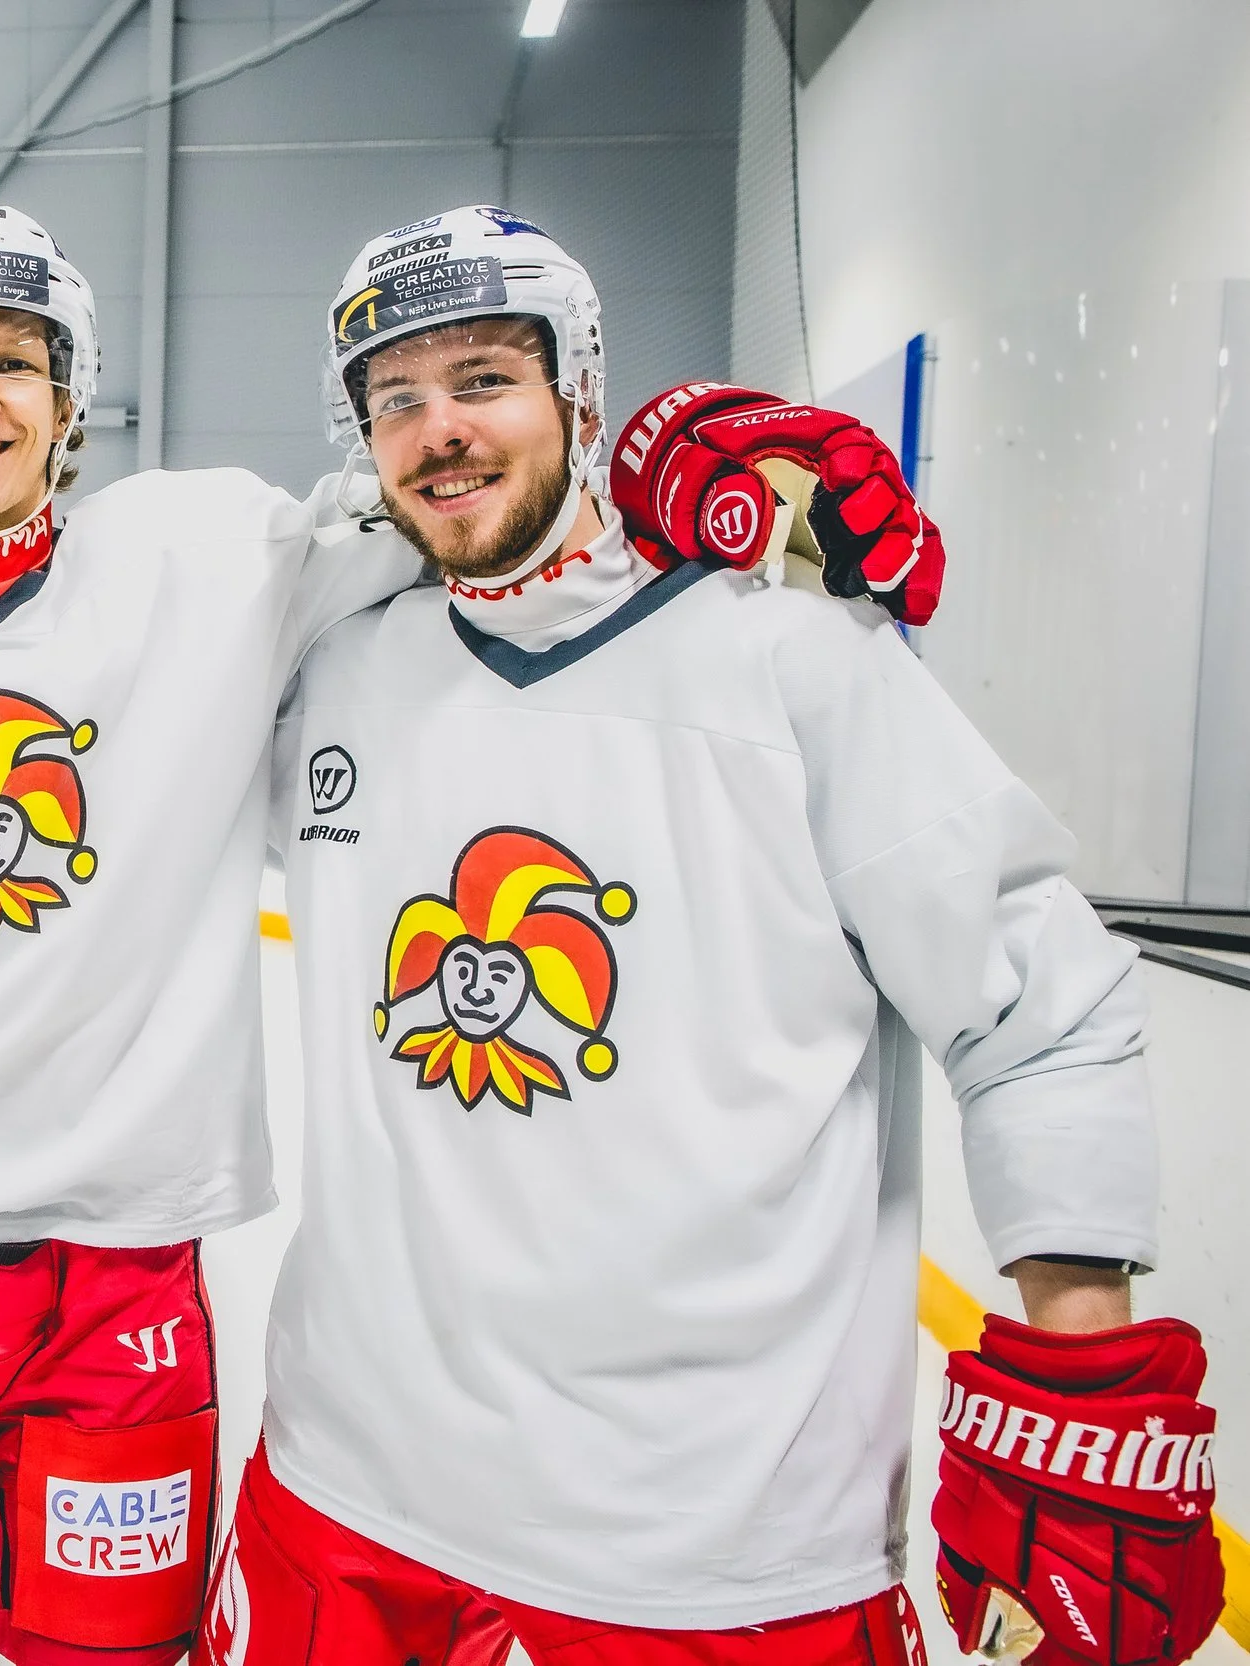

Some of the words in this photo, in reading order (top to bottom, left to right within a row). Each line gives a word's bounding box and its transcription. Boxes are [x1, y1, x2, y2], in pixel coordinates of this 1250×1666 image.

[373, 237, 446, 267] PAIKKA
[367, 251, 450, 286] WARRIOR
[393, 261, 489, 291] CREATIVE
[3, 286, 30, 297] Events
[396, 274, 490, 301] TECHNOLOGY
[408, 305, 427, 317] NEP
[428, 301, 447, 312] Live
[449, 295, 481, 306] Events
[732, 410, 813, 428] ALPHA
[51, 1480, 187, 1527] CABLE
[56, 1524, 181, 1571] CREW
